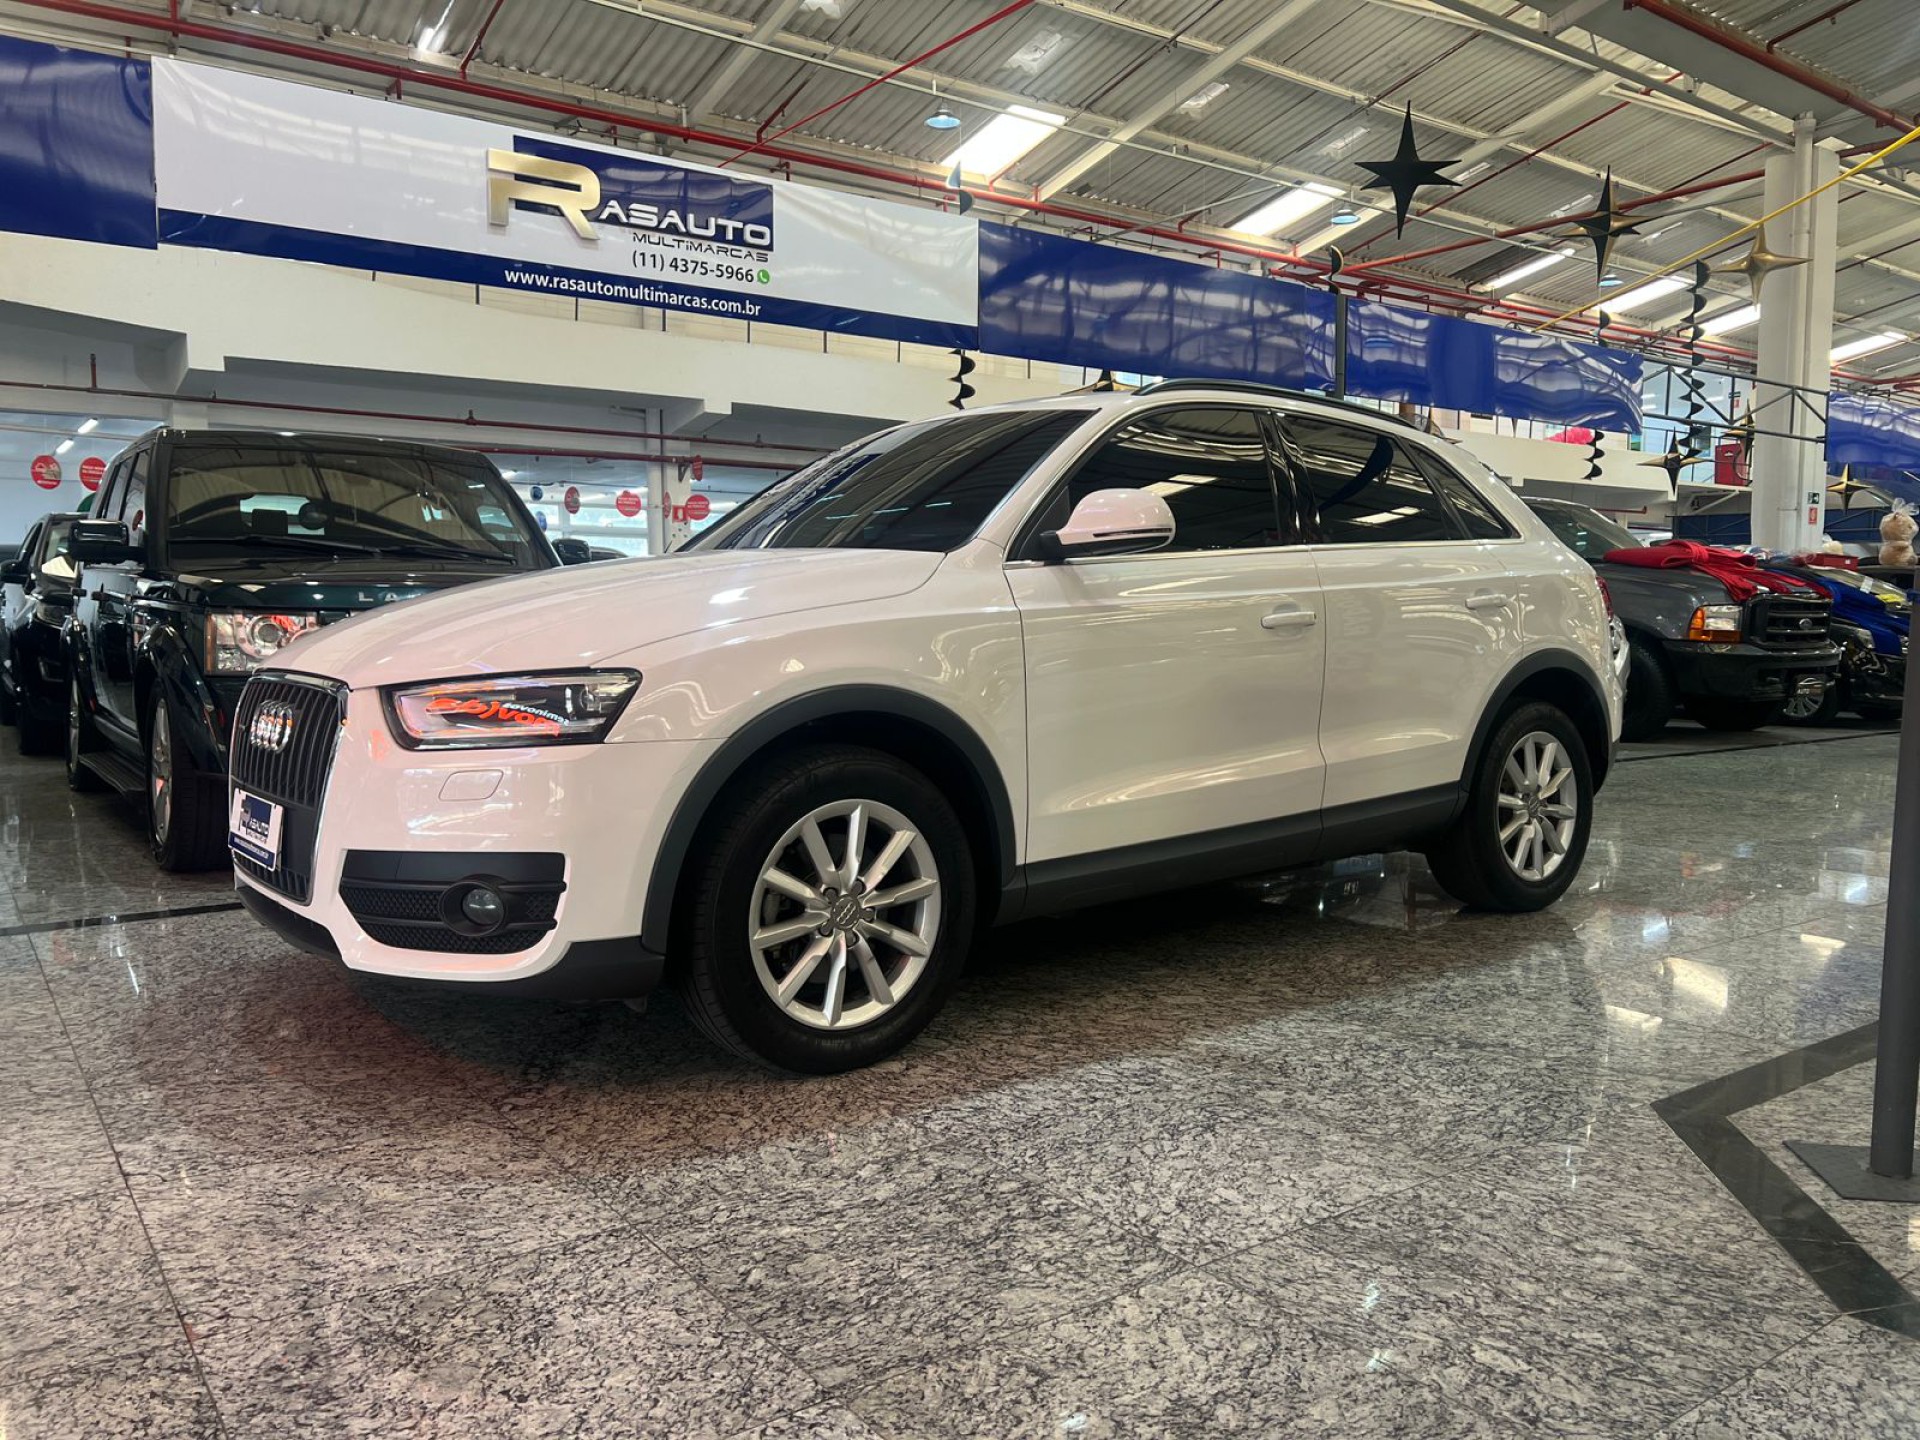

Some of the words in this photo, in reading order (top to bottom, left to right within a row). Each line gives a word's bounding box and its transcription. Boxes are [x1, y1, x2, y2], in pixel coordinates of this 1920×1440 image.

[632, 250, 665, 272] (11)
[669, 257, 754, 283] 4375-5966
[504, 269, 761, 316] www.rasautomultimarcas.com.br
[359, 591, 399, 601] LA
